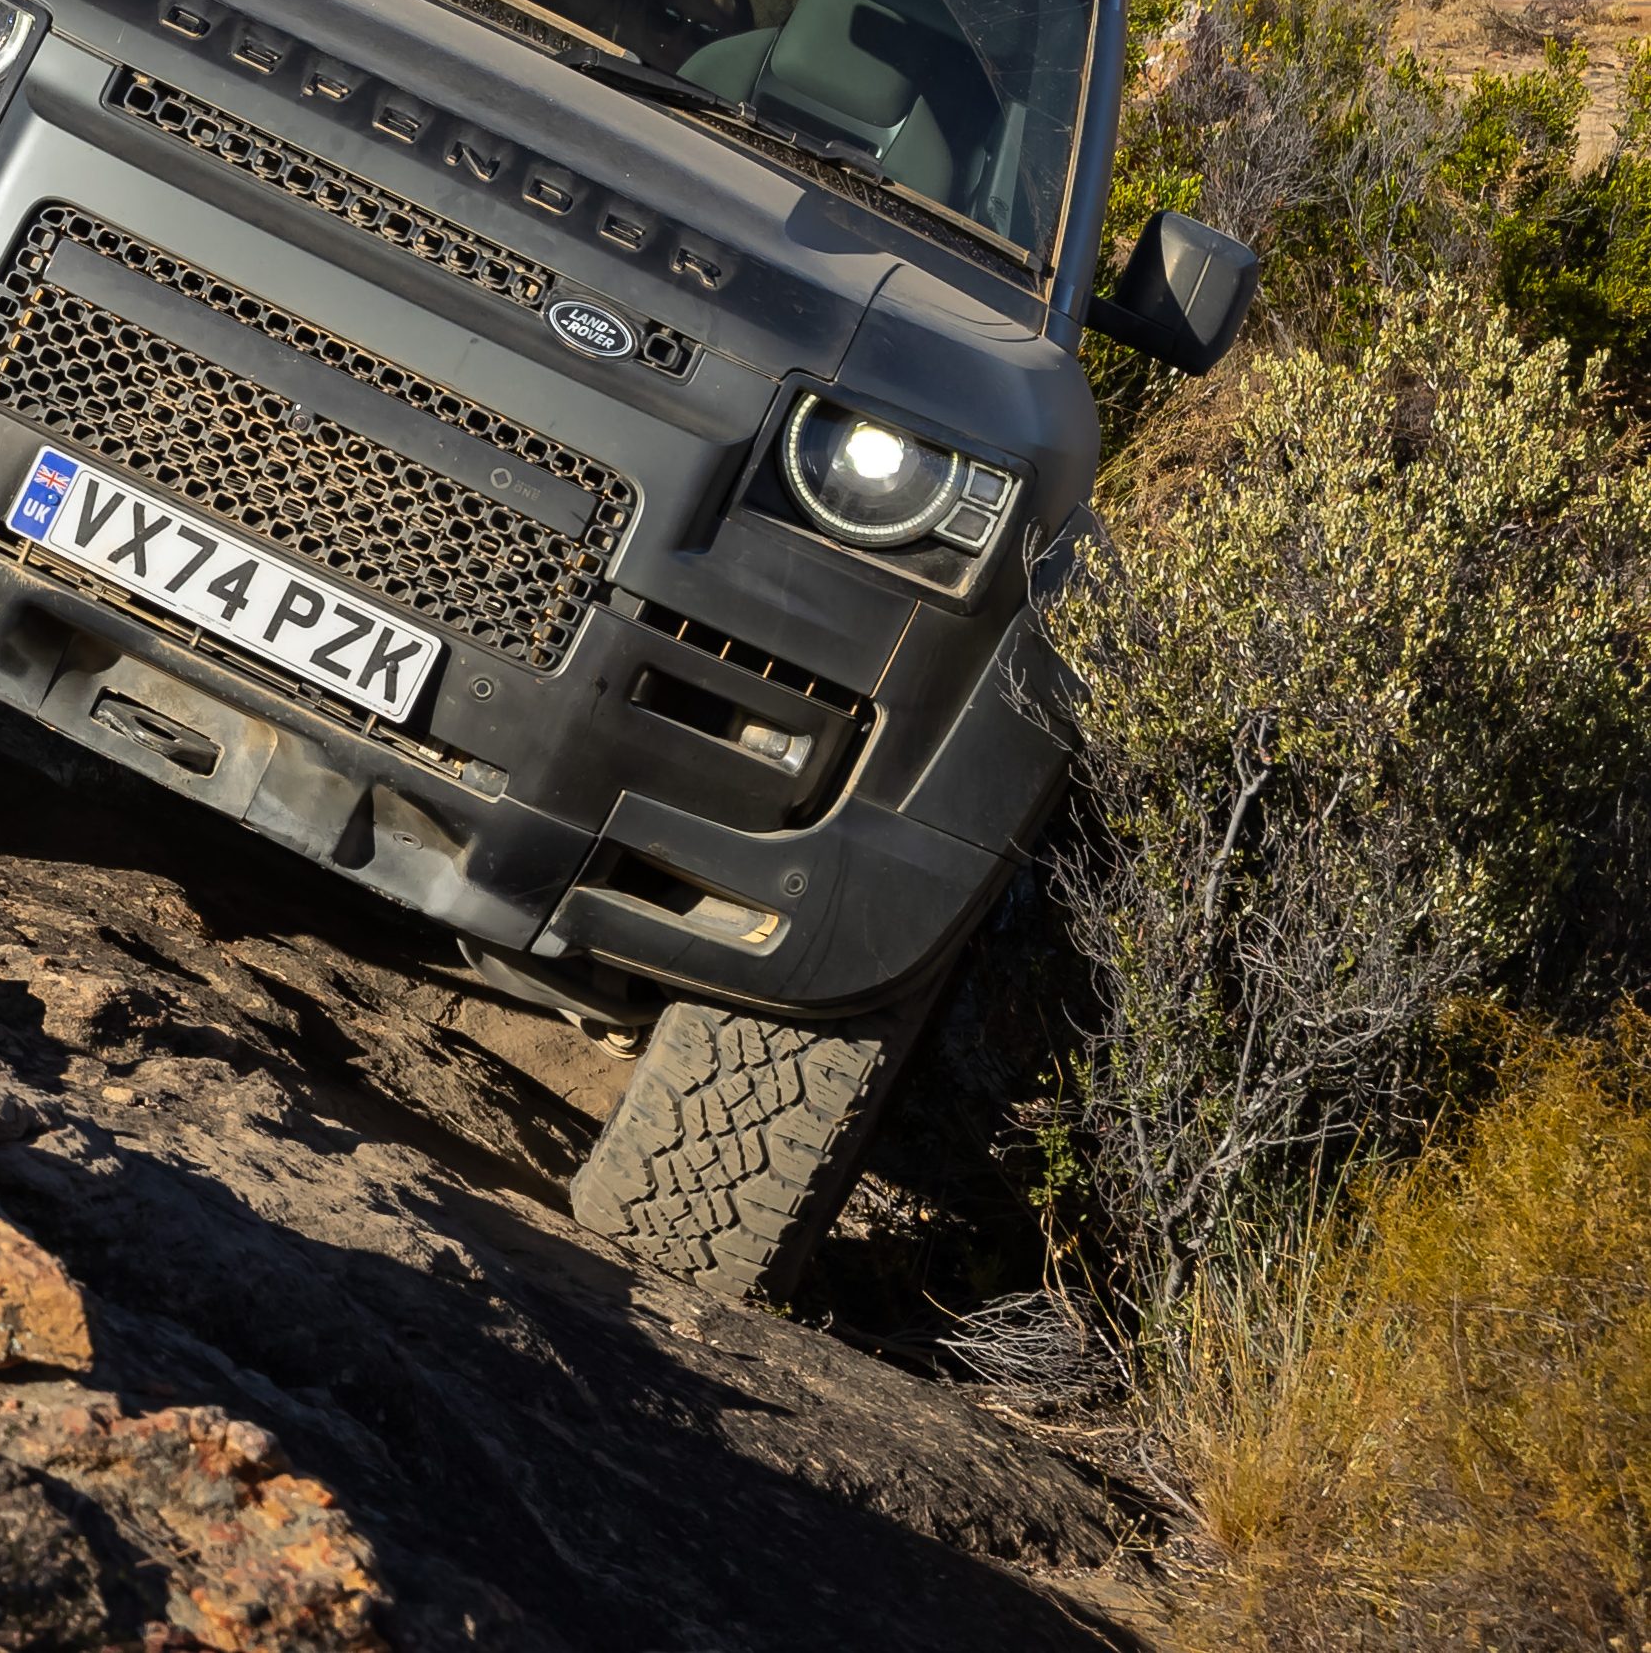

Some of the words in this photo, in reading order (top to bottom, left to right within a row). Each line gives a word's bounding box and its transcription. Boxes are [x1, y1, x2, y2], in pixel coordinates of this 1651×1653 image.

[159, 3, 723, 289] DEFENDER
[569, 308, 610, 333] LAND
[22, 497, 52, 524] UK
[74, 478, 261, 622] VX74
[262, 579, 423, 703] PZK
